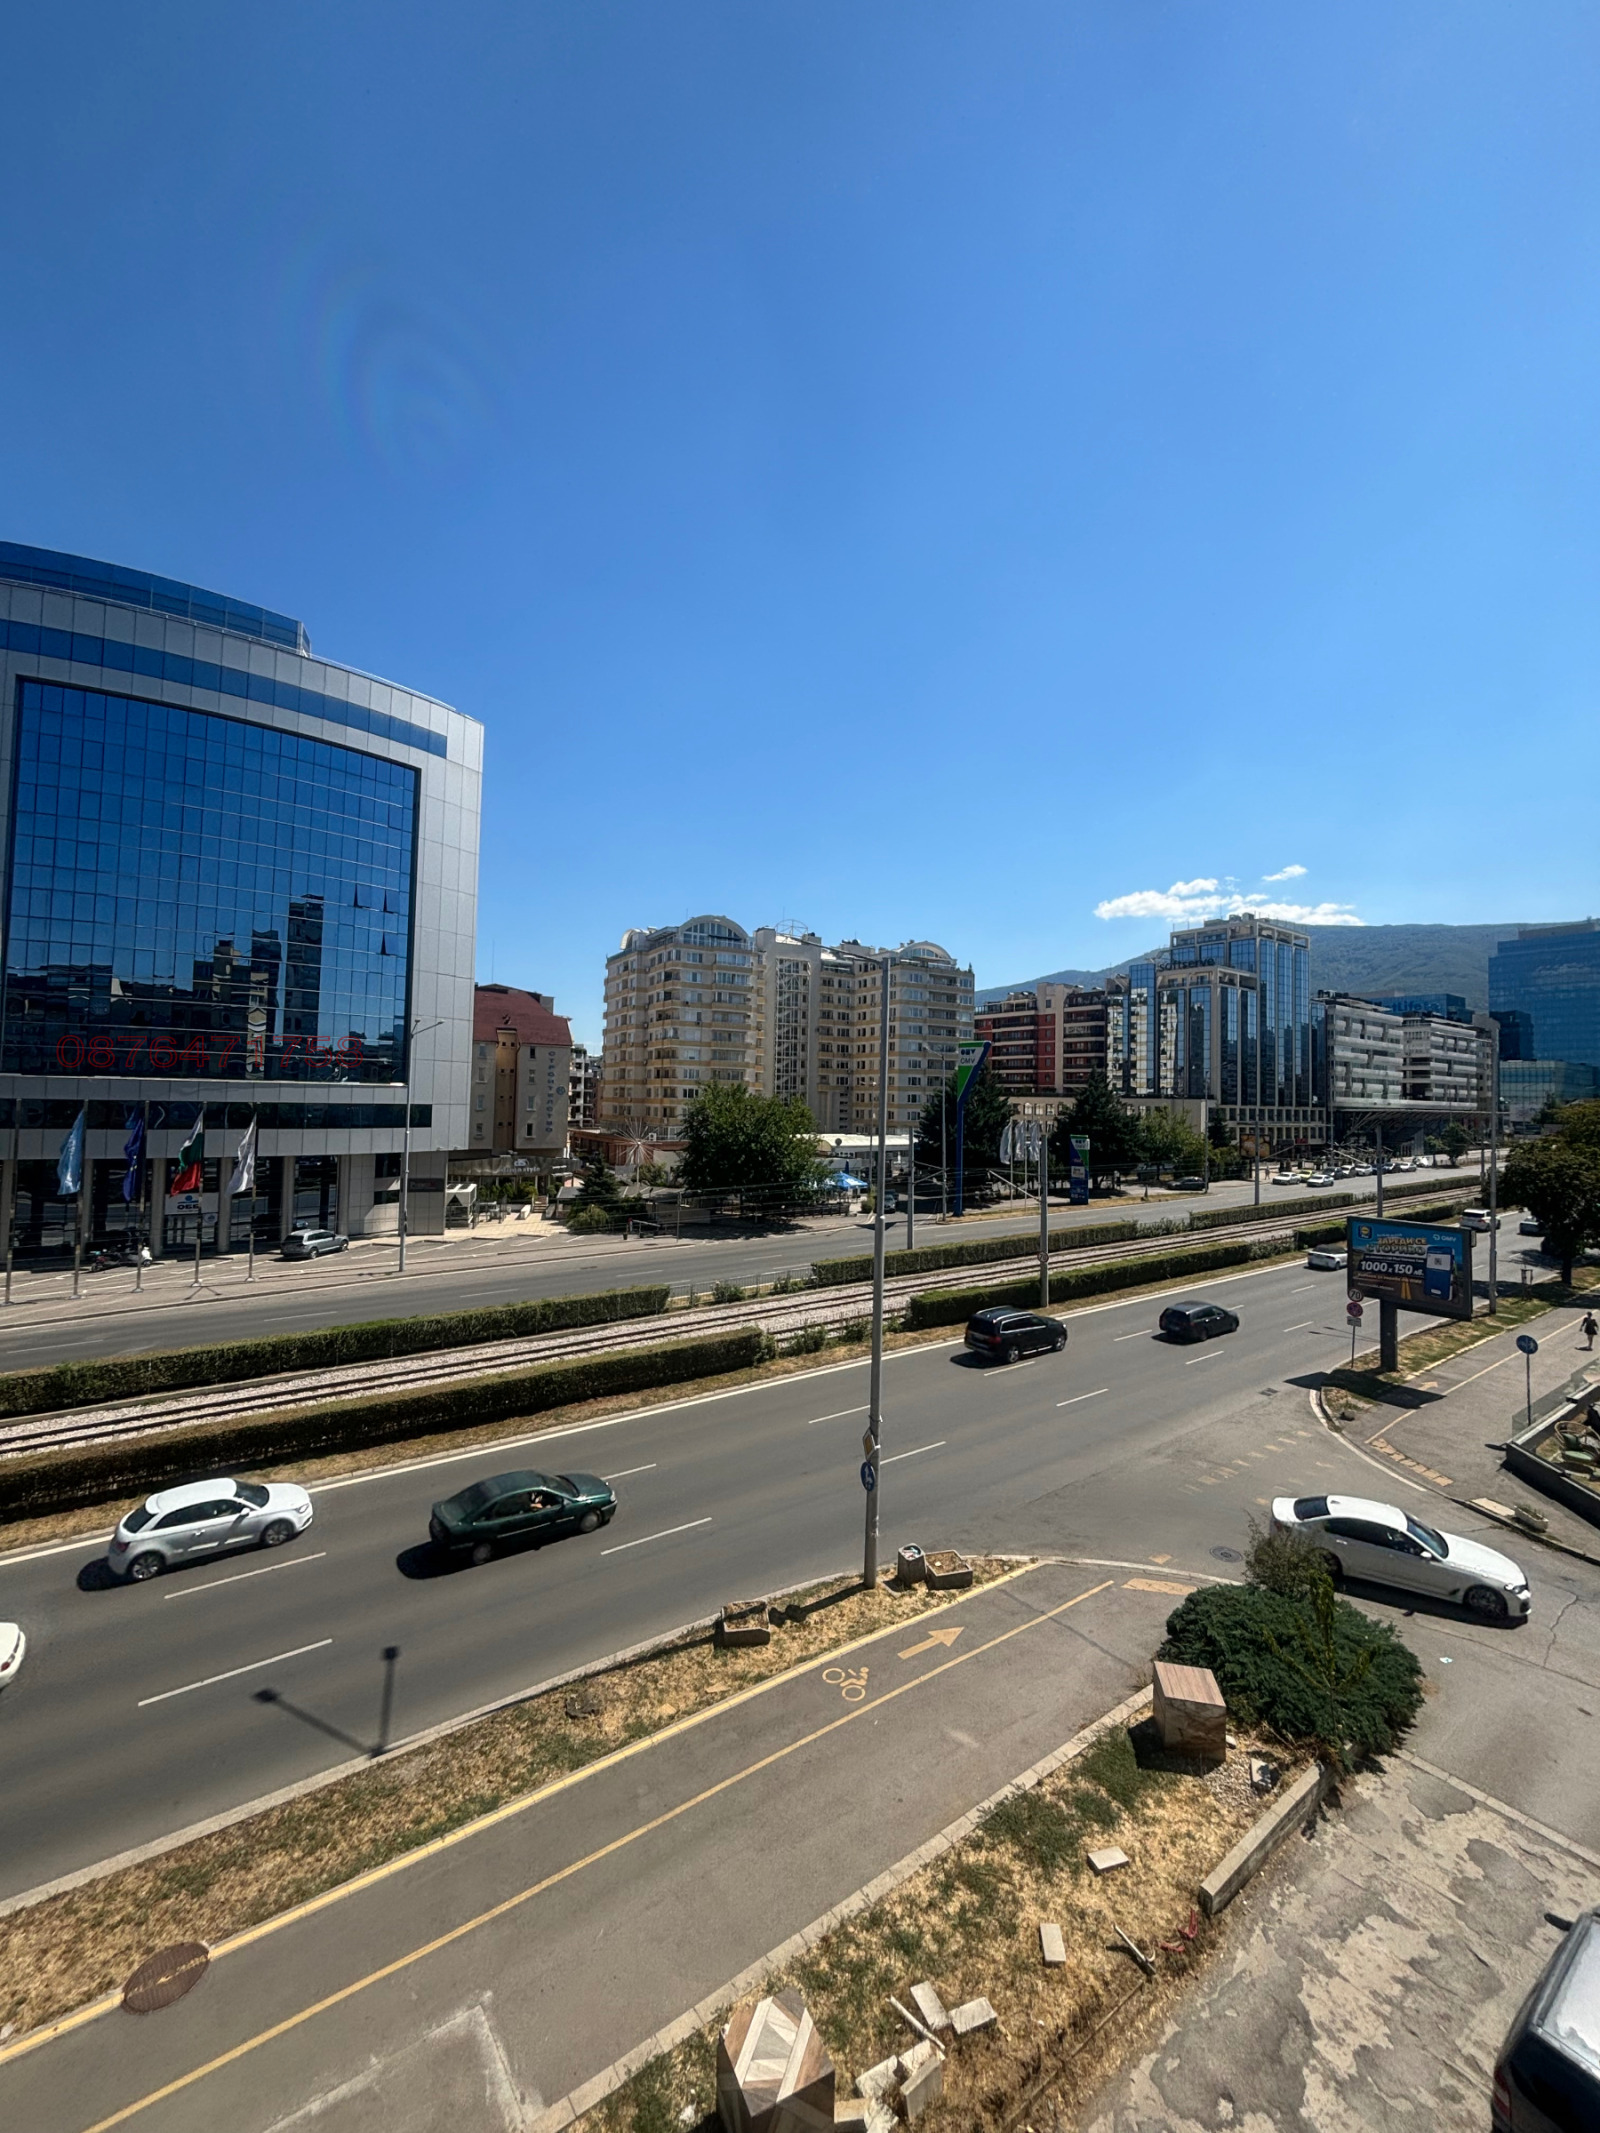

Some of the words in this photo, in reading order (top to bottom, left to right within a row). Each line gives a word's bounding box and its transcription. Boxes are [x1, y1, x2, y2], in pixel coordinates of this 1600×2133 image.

[1159, 957, 1215, 972] softserve
[960, 1057, 976, 1065] OMV
[1360, 1261, 1388, 1272] 1000
[1394, 1263, 1413, 1275] 150
[1350, 1290, 1361, 1299] 70
